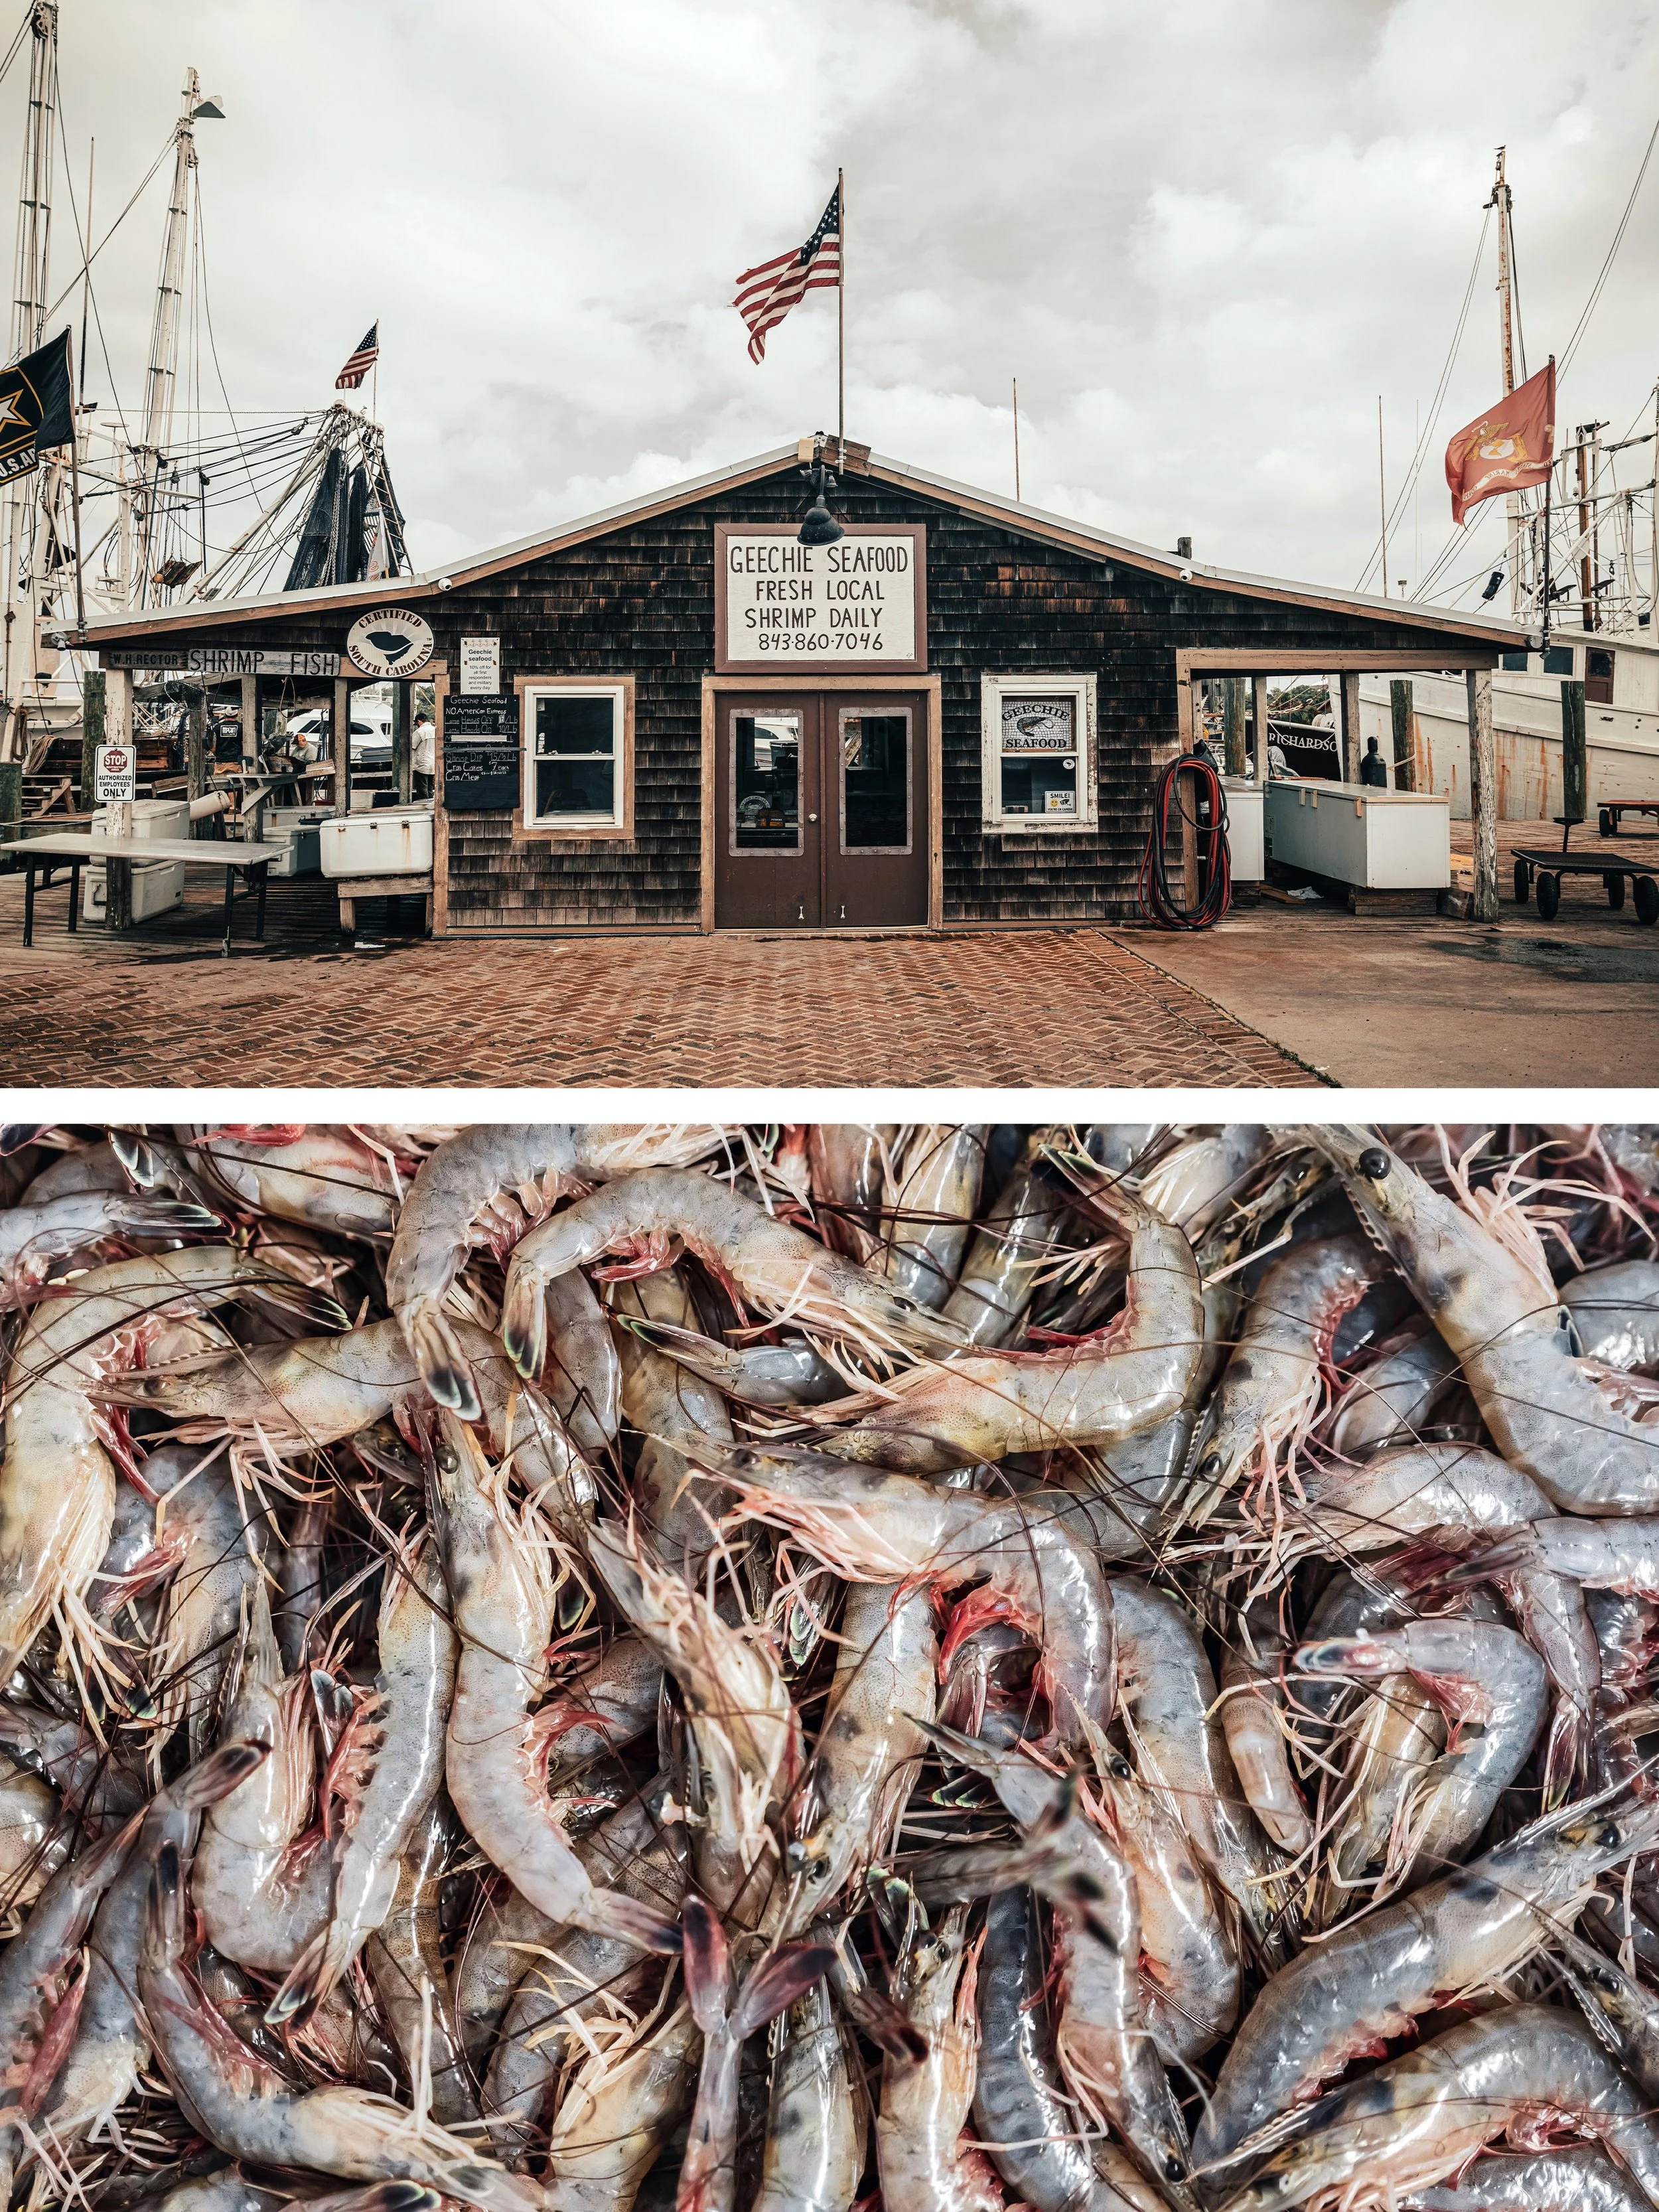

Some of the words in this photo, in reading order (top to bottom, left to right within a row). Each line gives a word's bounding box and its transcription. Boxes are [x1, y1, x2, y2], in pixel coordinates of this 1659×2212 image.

[731, 546, 814, 573] GEECHIE
[827, 546, 908, 573] SEAFOOD
[756, 579, 812, 601] FRESH
[827, 579, 885, 601] LOCAL
[358, 610, 422, 628] CERTIFIED
[745, 608, 816, 628] SHRIMP
[830, 608, 883, 628] DAILY
[190, 650, 264, 672] SHRIMP
[291, 653, 334, 676] FISH
[349, 645, 382, 675] SOUTH
[386, 643, 433, 676] CAROLINA
[1001, 704, 1070, 721] GEECHIE
[1006, 738, 1067, 748] SEAFOOD
[1269, 733, 1337, 751] RICHARDSO
[105, 755, 126, 765] STOP
[103, 788, 126, 797] ONLY
